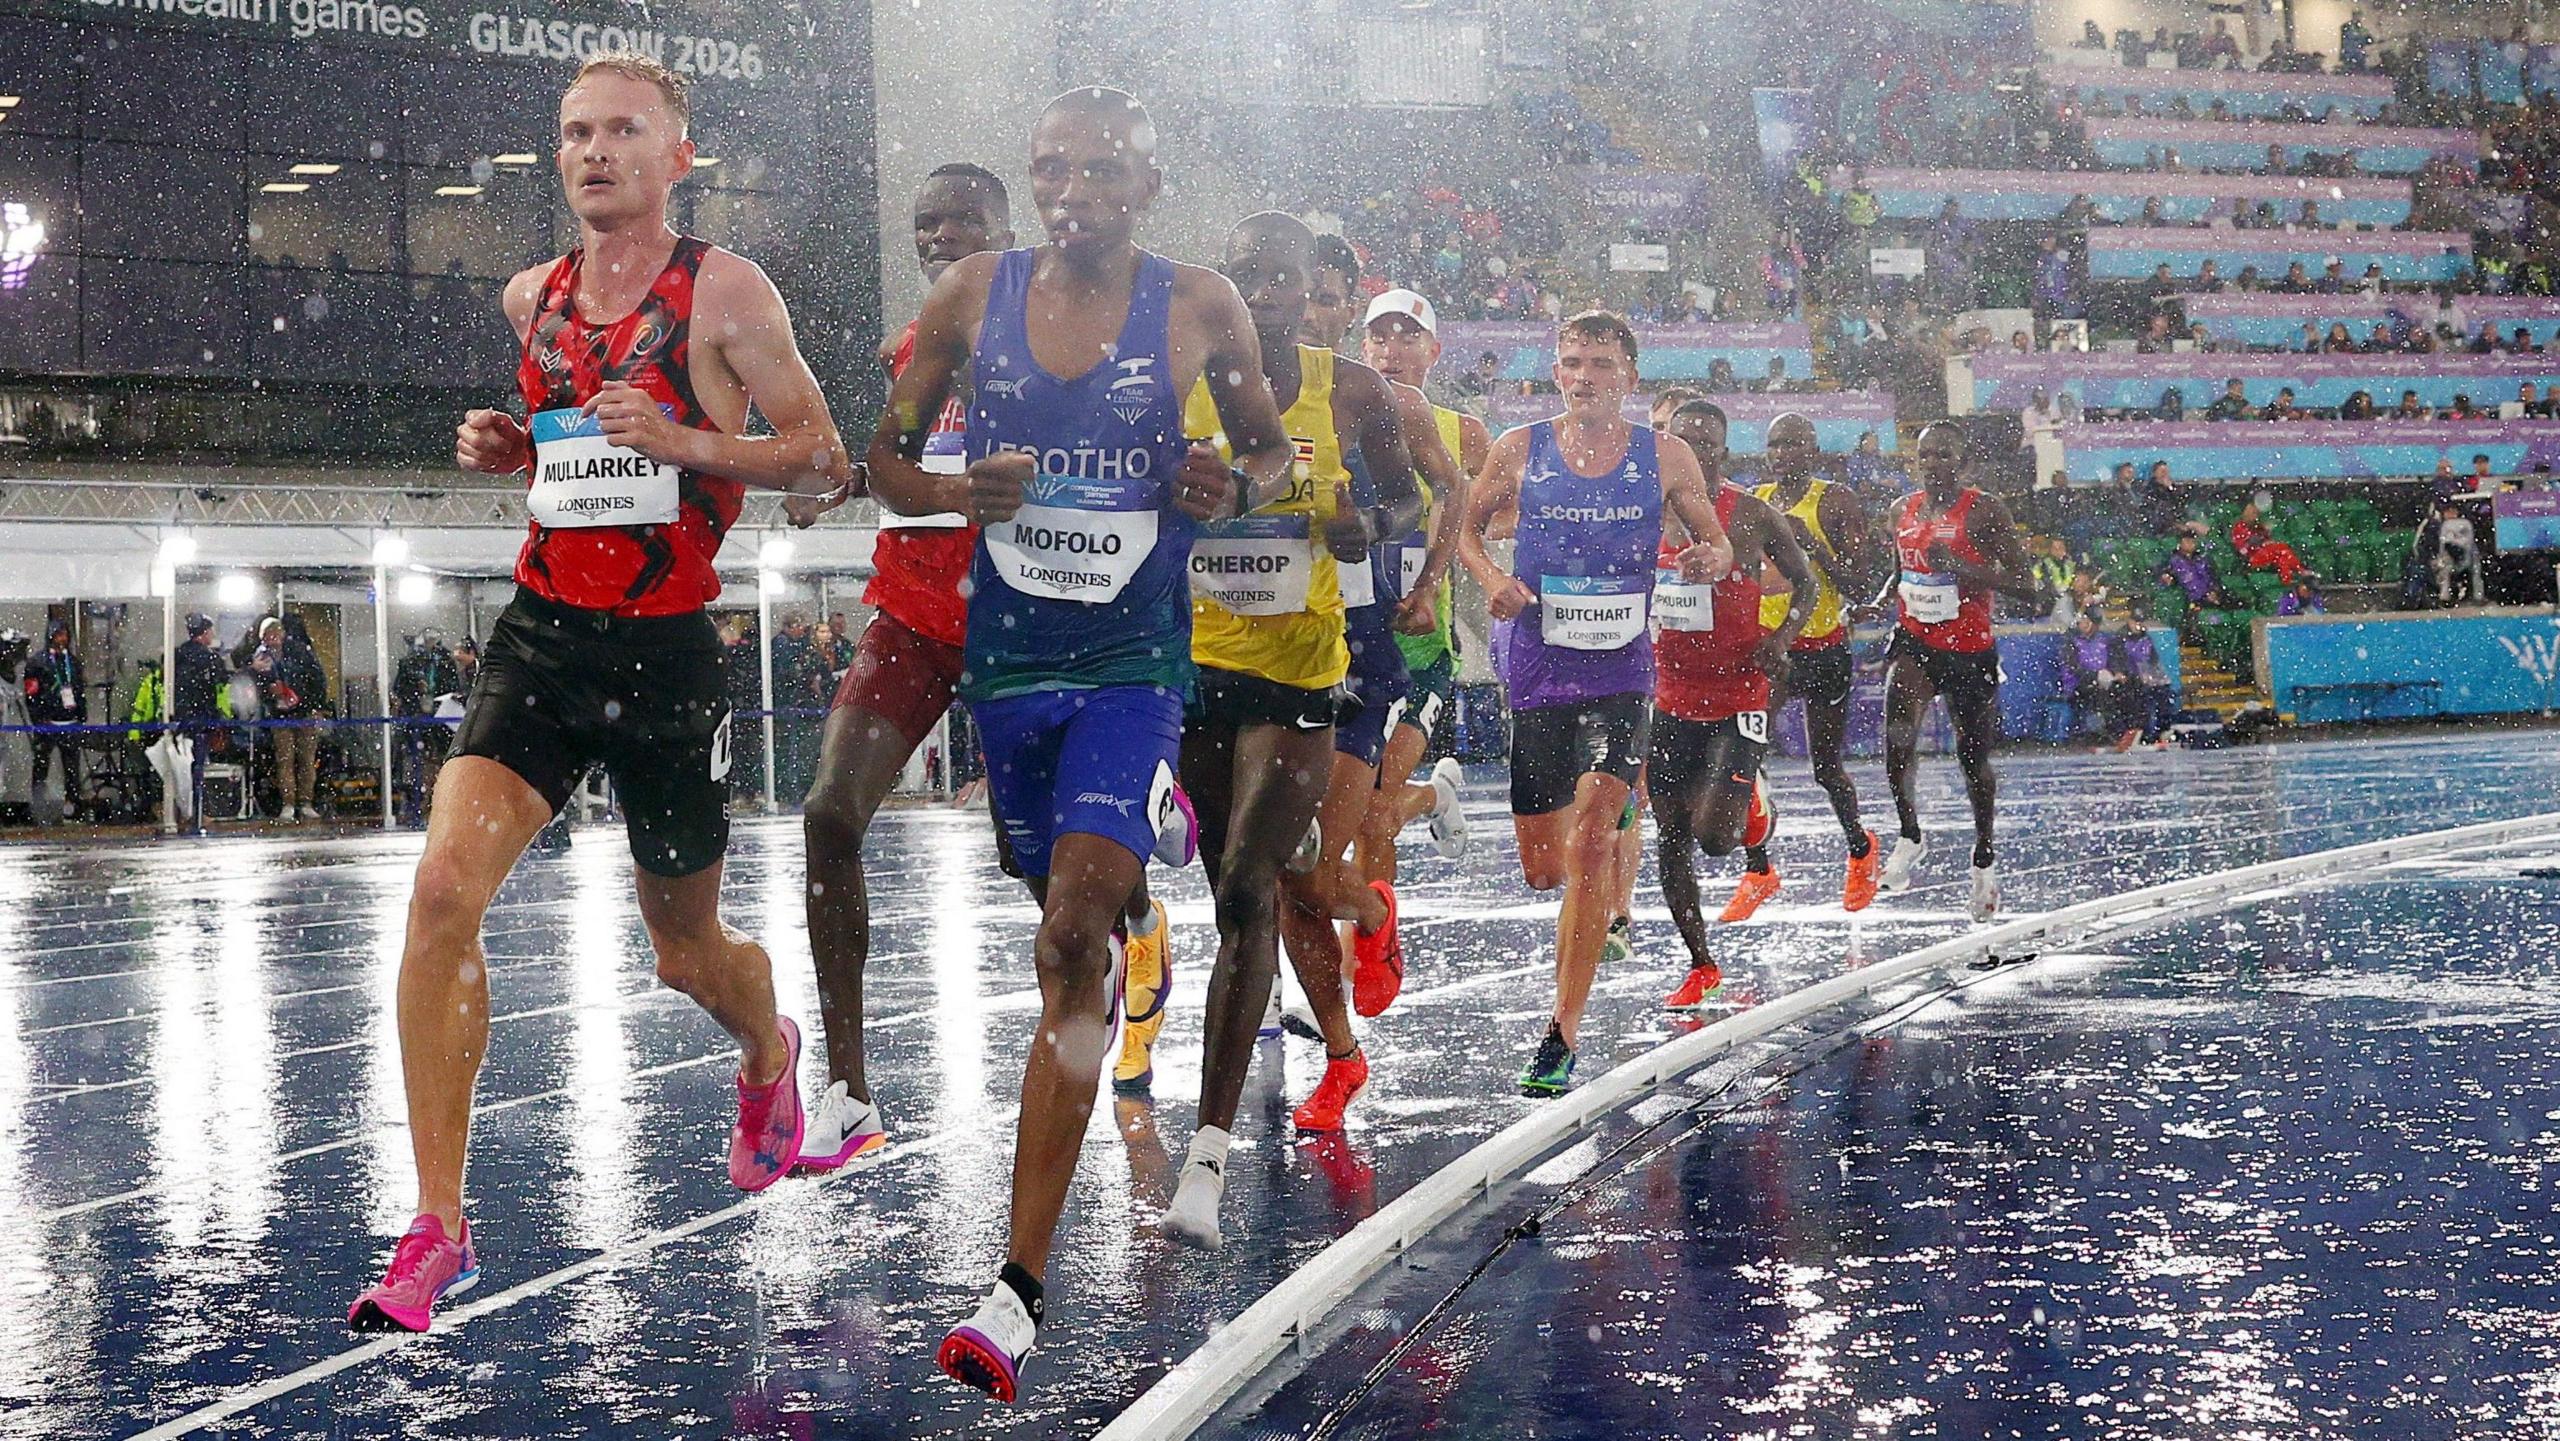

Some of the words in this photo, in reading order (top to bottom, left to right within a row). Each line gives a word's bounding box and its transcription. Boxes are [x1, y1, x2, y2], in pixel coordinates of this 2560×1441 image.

[290, 0, 426, 38] games
[469, 12, 665, 62] GLASGOW
[674, 36, 763, 80] 2026
[544, 456, 663, 483] MULLARKEY
[556, 497, 634, 512] LONGINES
[1541, 504, 1643, 522] SCOTLAND
[1014, 523, 1121, 555] MOFOLO
[1019, 564, 1112, 587] LONGINES
[1191, 555, 1290, 574] CHEROP
[1555, 607, 1632, 622] BUTCHART
[1567, 631, 1621, 641] LONGINES
[1741, 713, 1764, 735] 13
